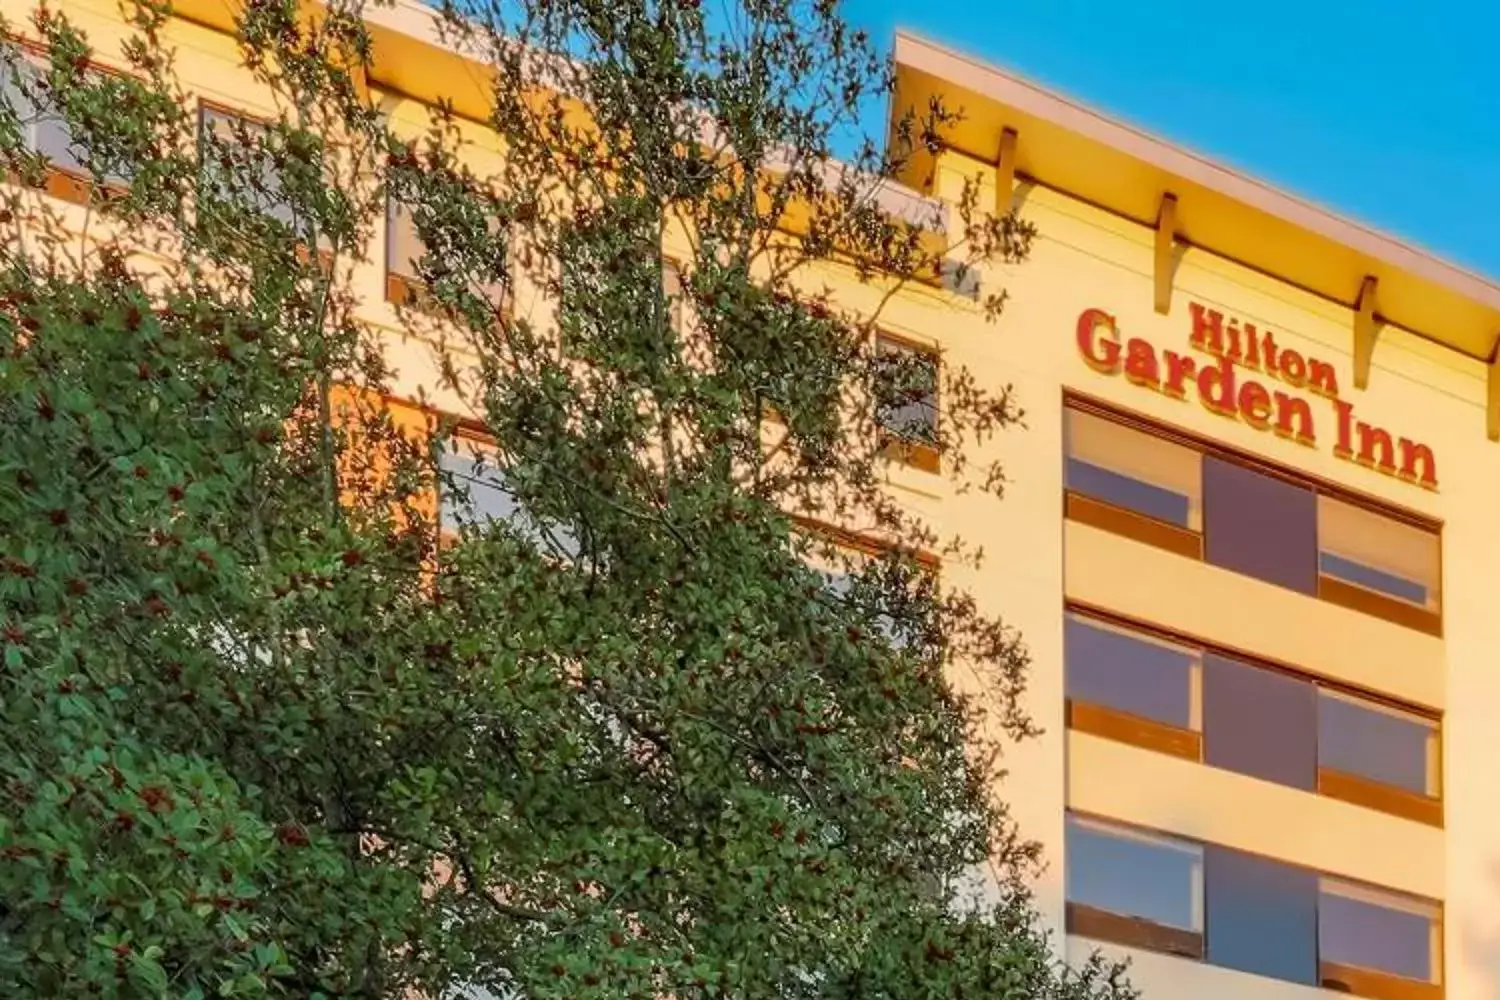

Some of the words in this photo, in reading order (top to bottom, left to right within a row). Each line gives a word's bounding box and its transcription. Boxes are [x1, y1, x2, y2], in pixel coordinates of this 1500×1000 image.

[1076, 307, 1317, 449] Garden
[1332, 398, 1439, 493] Inn
[1188, 302, 1338, 396] Hilton
